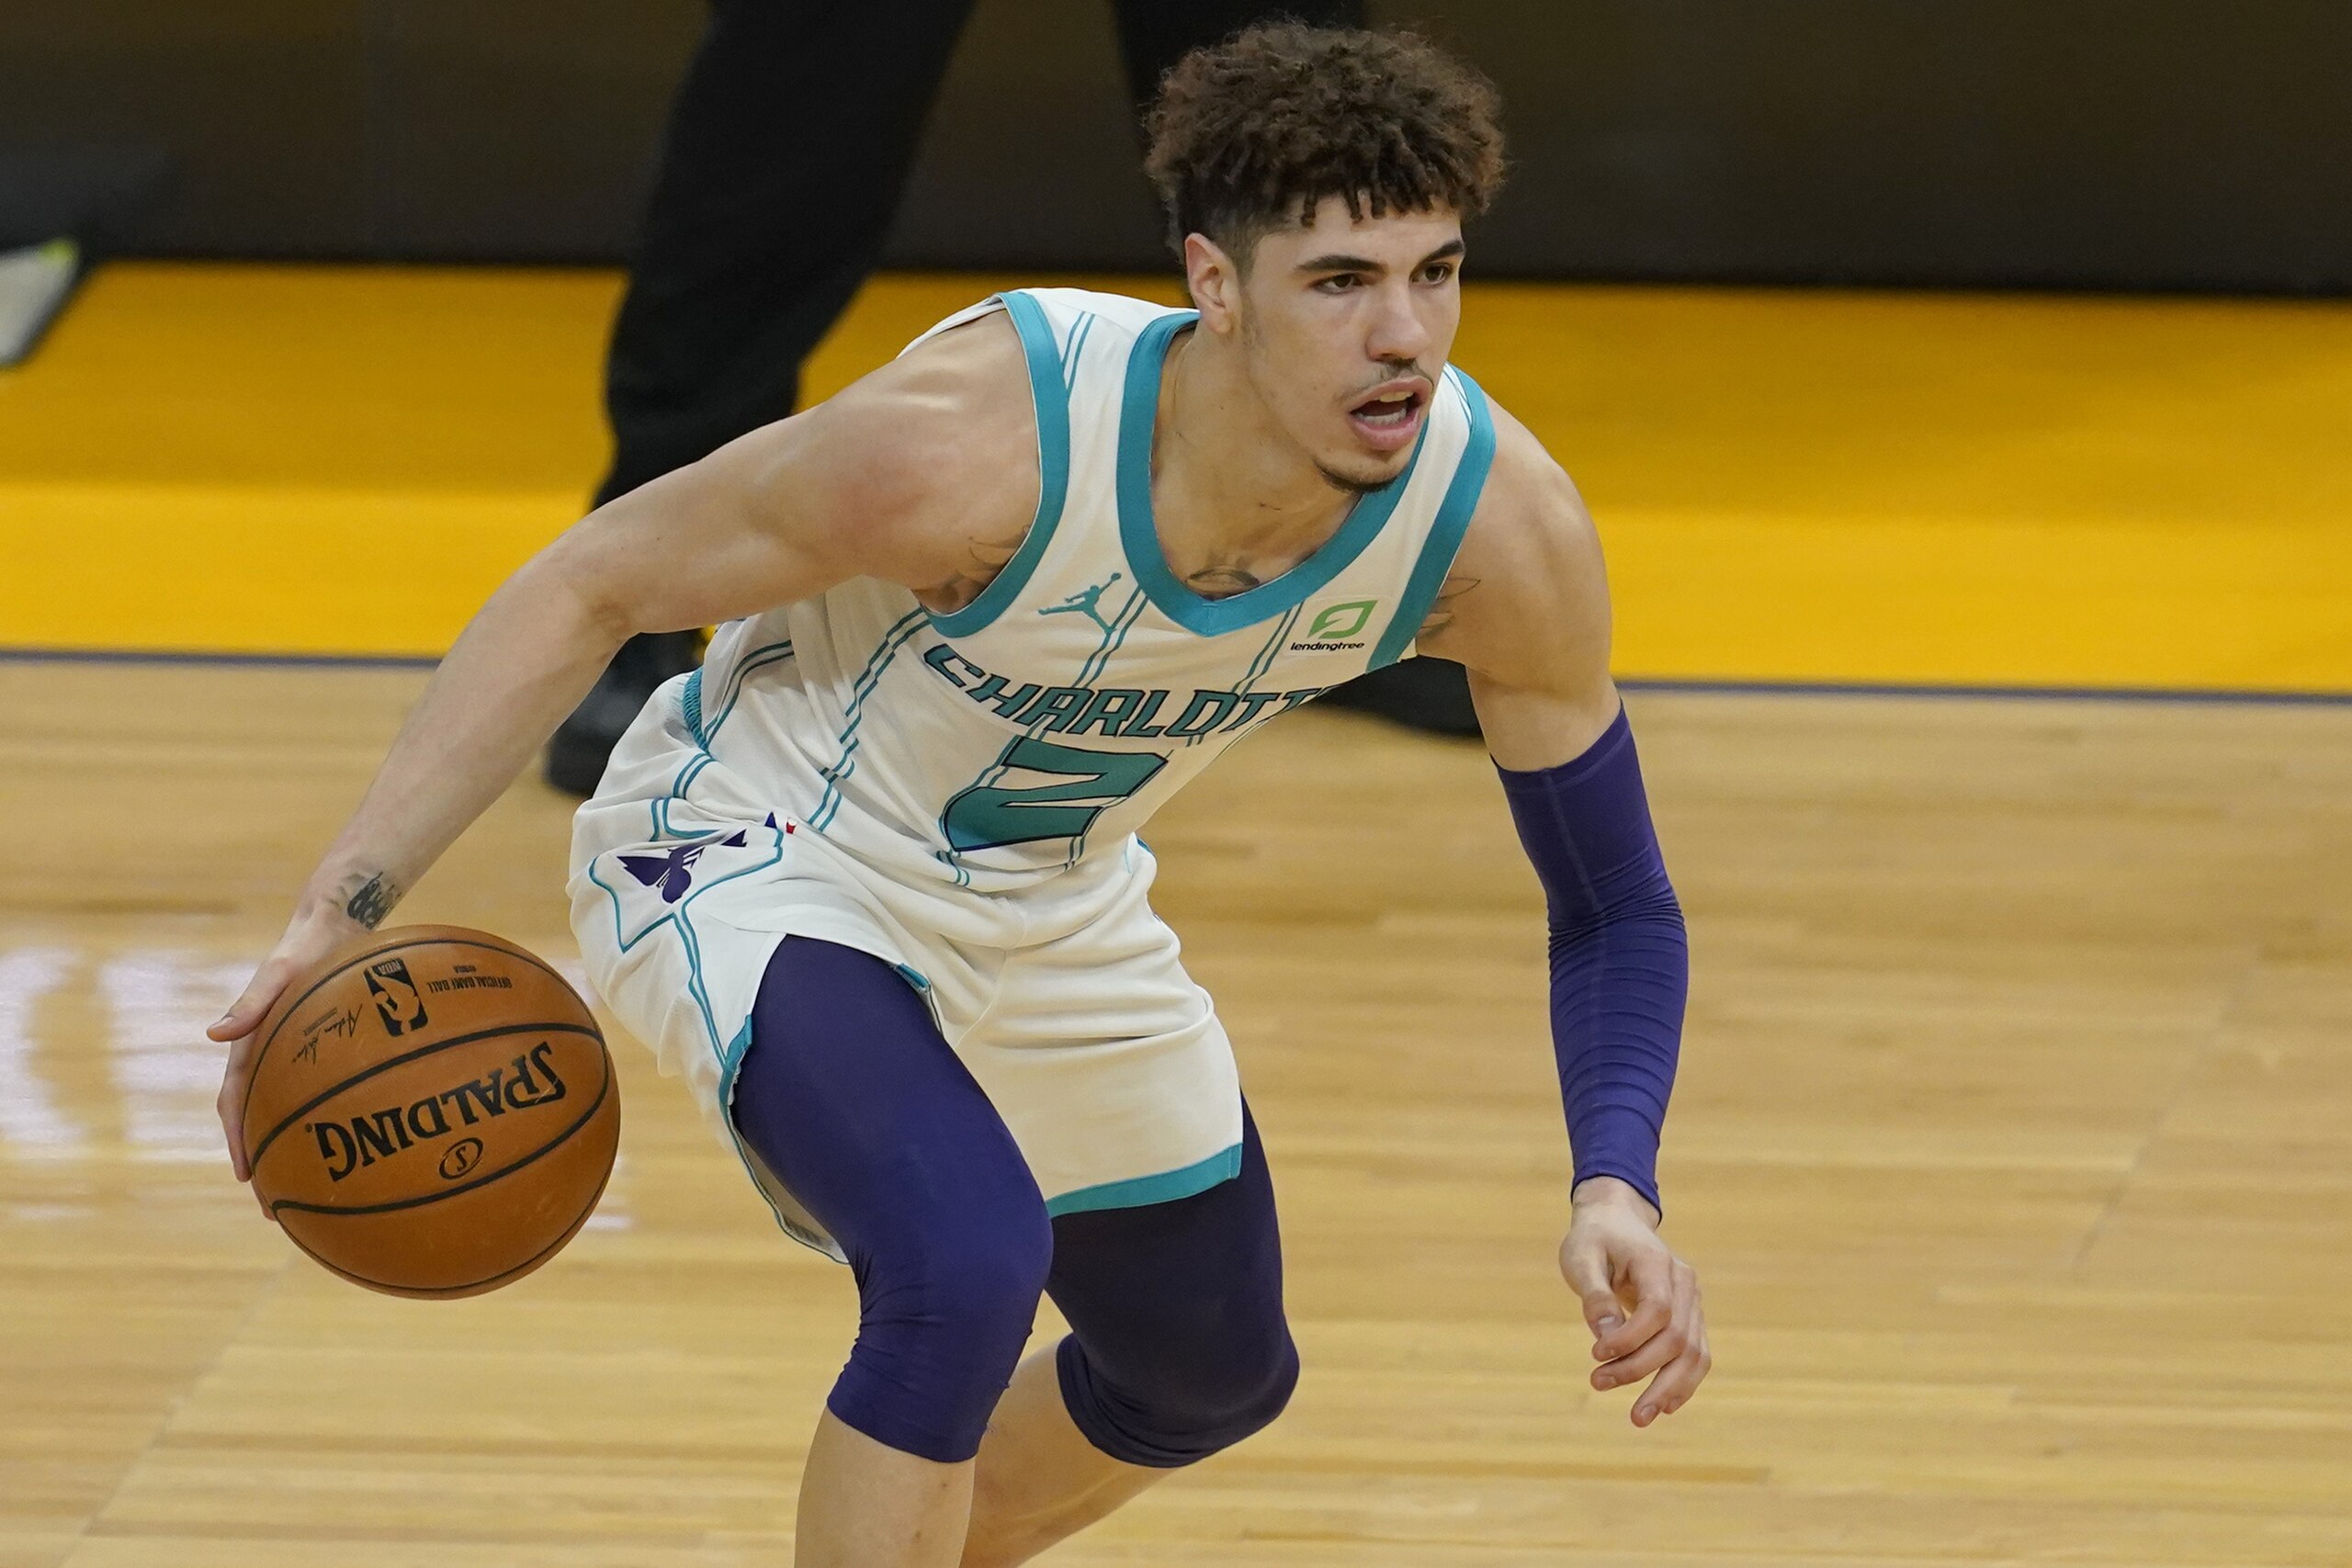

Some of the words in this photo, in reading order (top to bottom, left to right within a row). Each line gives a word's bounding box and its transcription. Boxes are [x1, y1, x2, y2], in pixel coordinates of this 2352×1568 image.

[1290, 641, 1364, 651] lendingtree
[923, 644, 1325, 738] CHARLOTT
[944, 736, 1169, 852] 2
[426, 980, 450, 994] BALL
[477, 976, 513, 989] OFFICIAL
[312, 1041, 567, 1182] SPALDING
